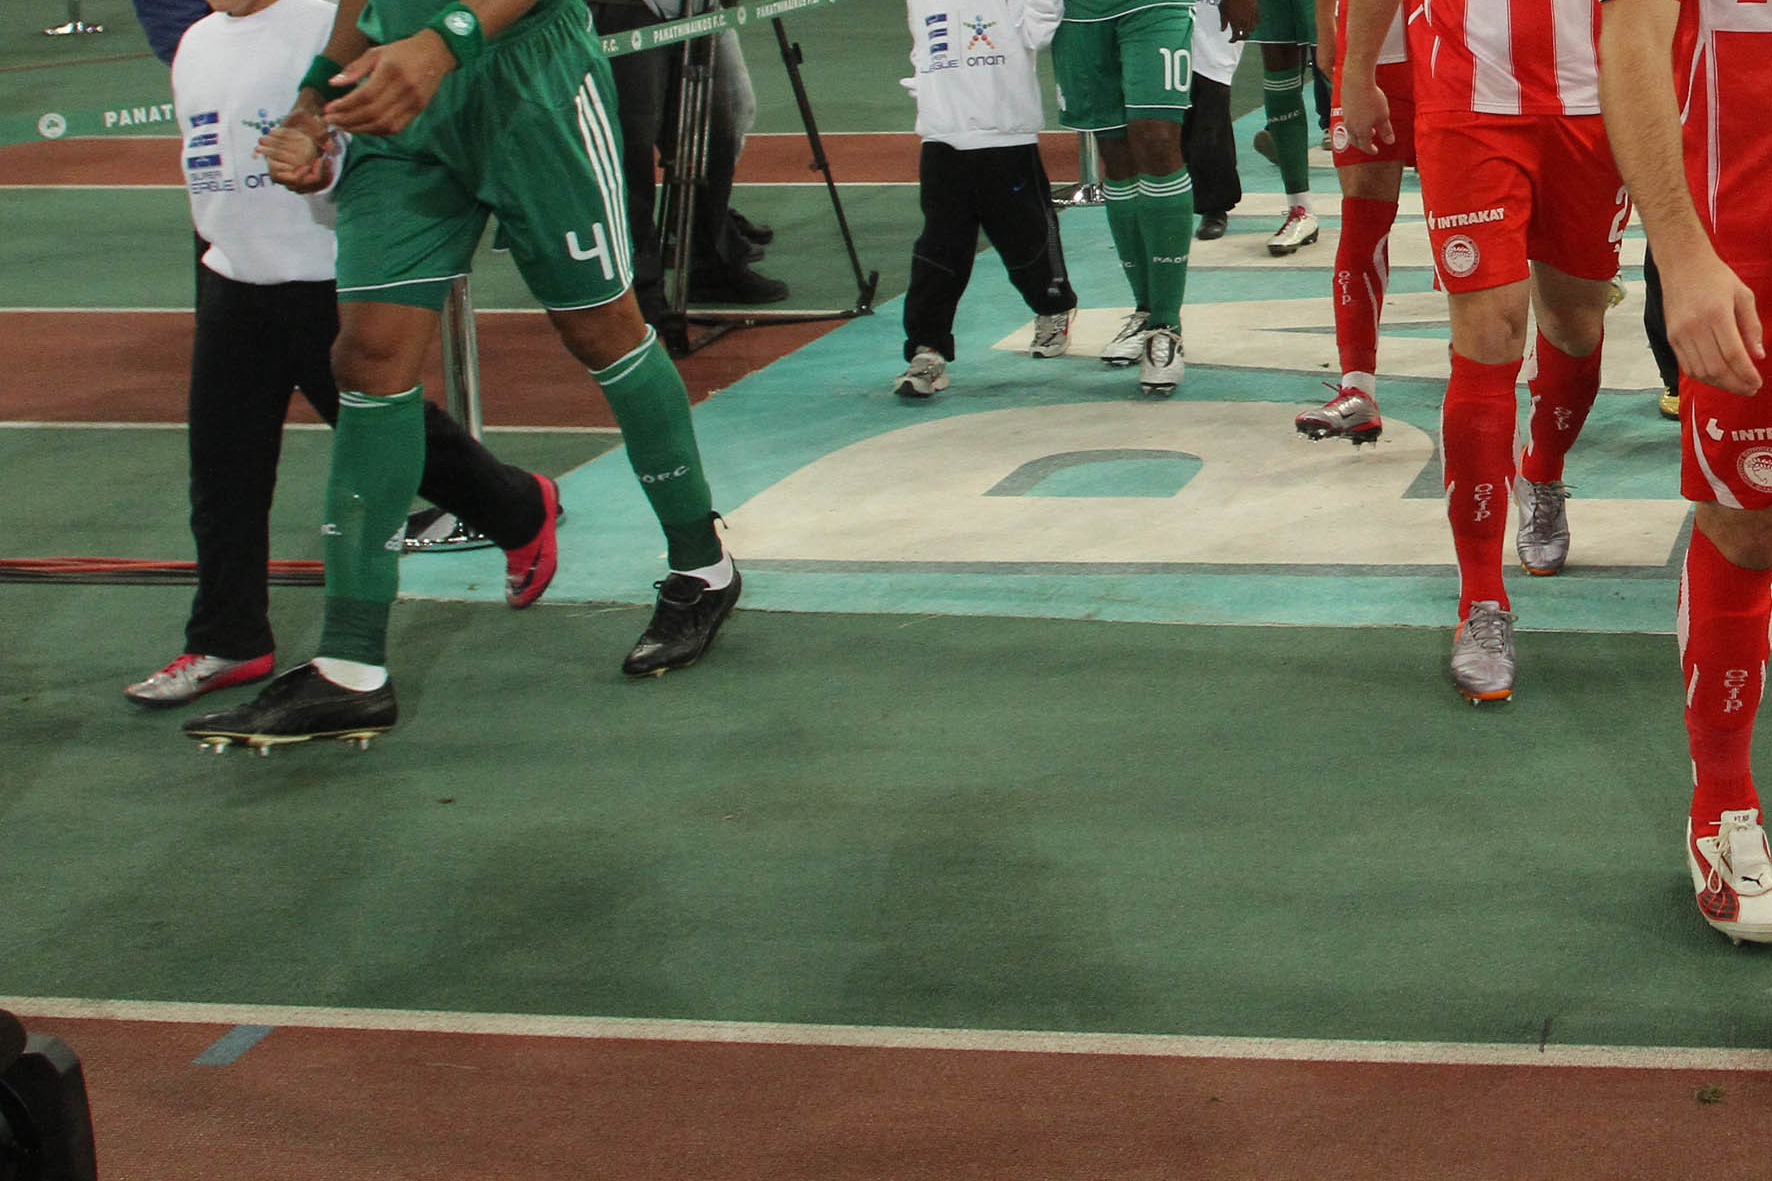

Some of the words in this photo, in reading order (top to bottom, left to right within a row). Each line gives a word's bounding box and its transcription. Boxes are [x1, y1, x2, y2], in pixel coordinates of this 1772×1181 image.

[1159, 47, 1192, 92] 10
[1437, 208, 1505, 230] INTRAKAT
[565, 222, 615, 281] 4
